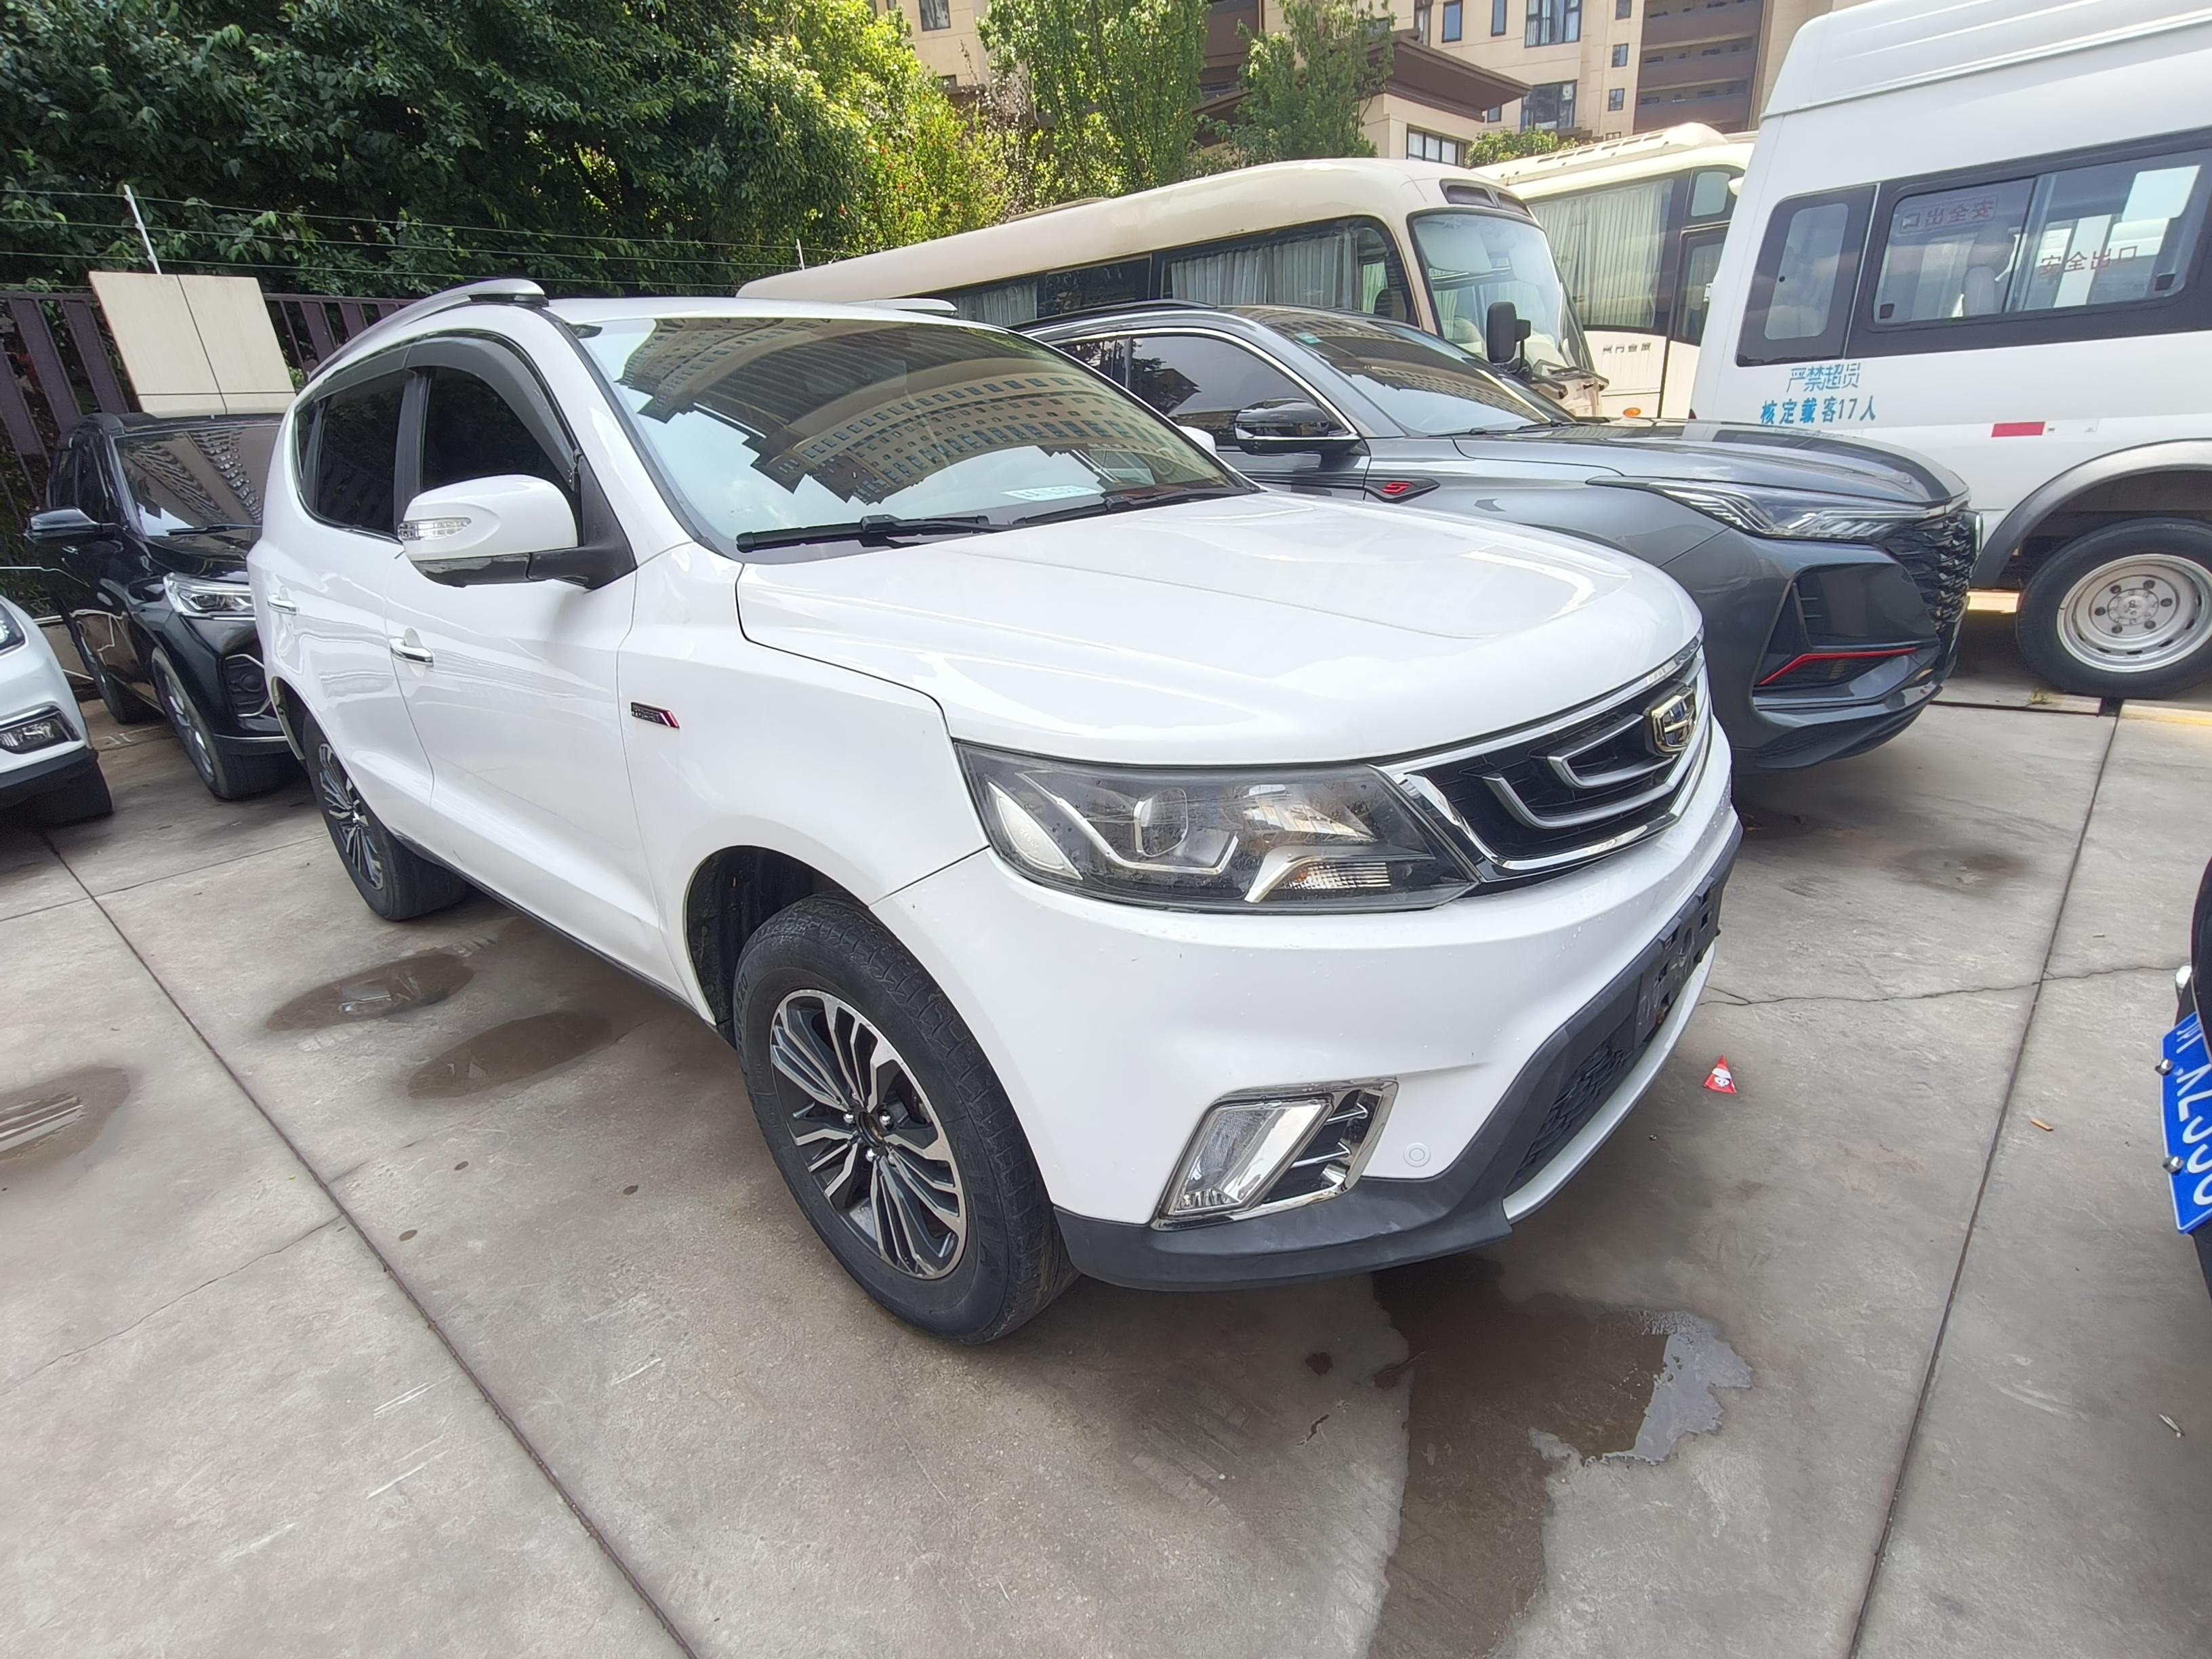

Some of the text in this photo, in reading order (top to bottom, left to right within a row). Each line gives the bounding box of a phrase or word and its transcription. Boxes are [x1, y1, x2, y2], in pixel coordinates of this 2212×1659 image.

[2040, 245, 2138, 277] 安全出口
[1786, 363, 1861, 393] 严禁超员
[1760, 395, 1876, 425] 核定载客17人
